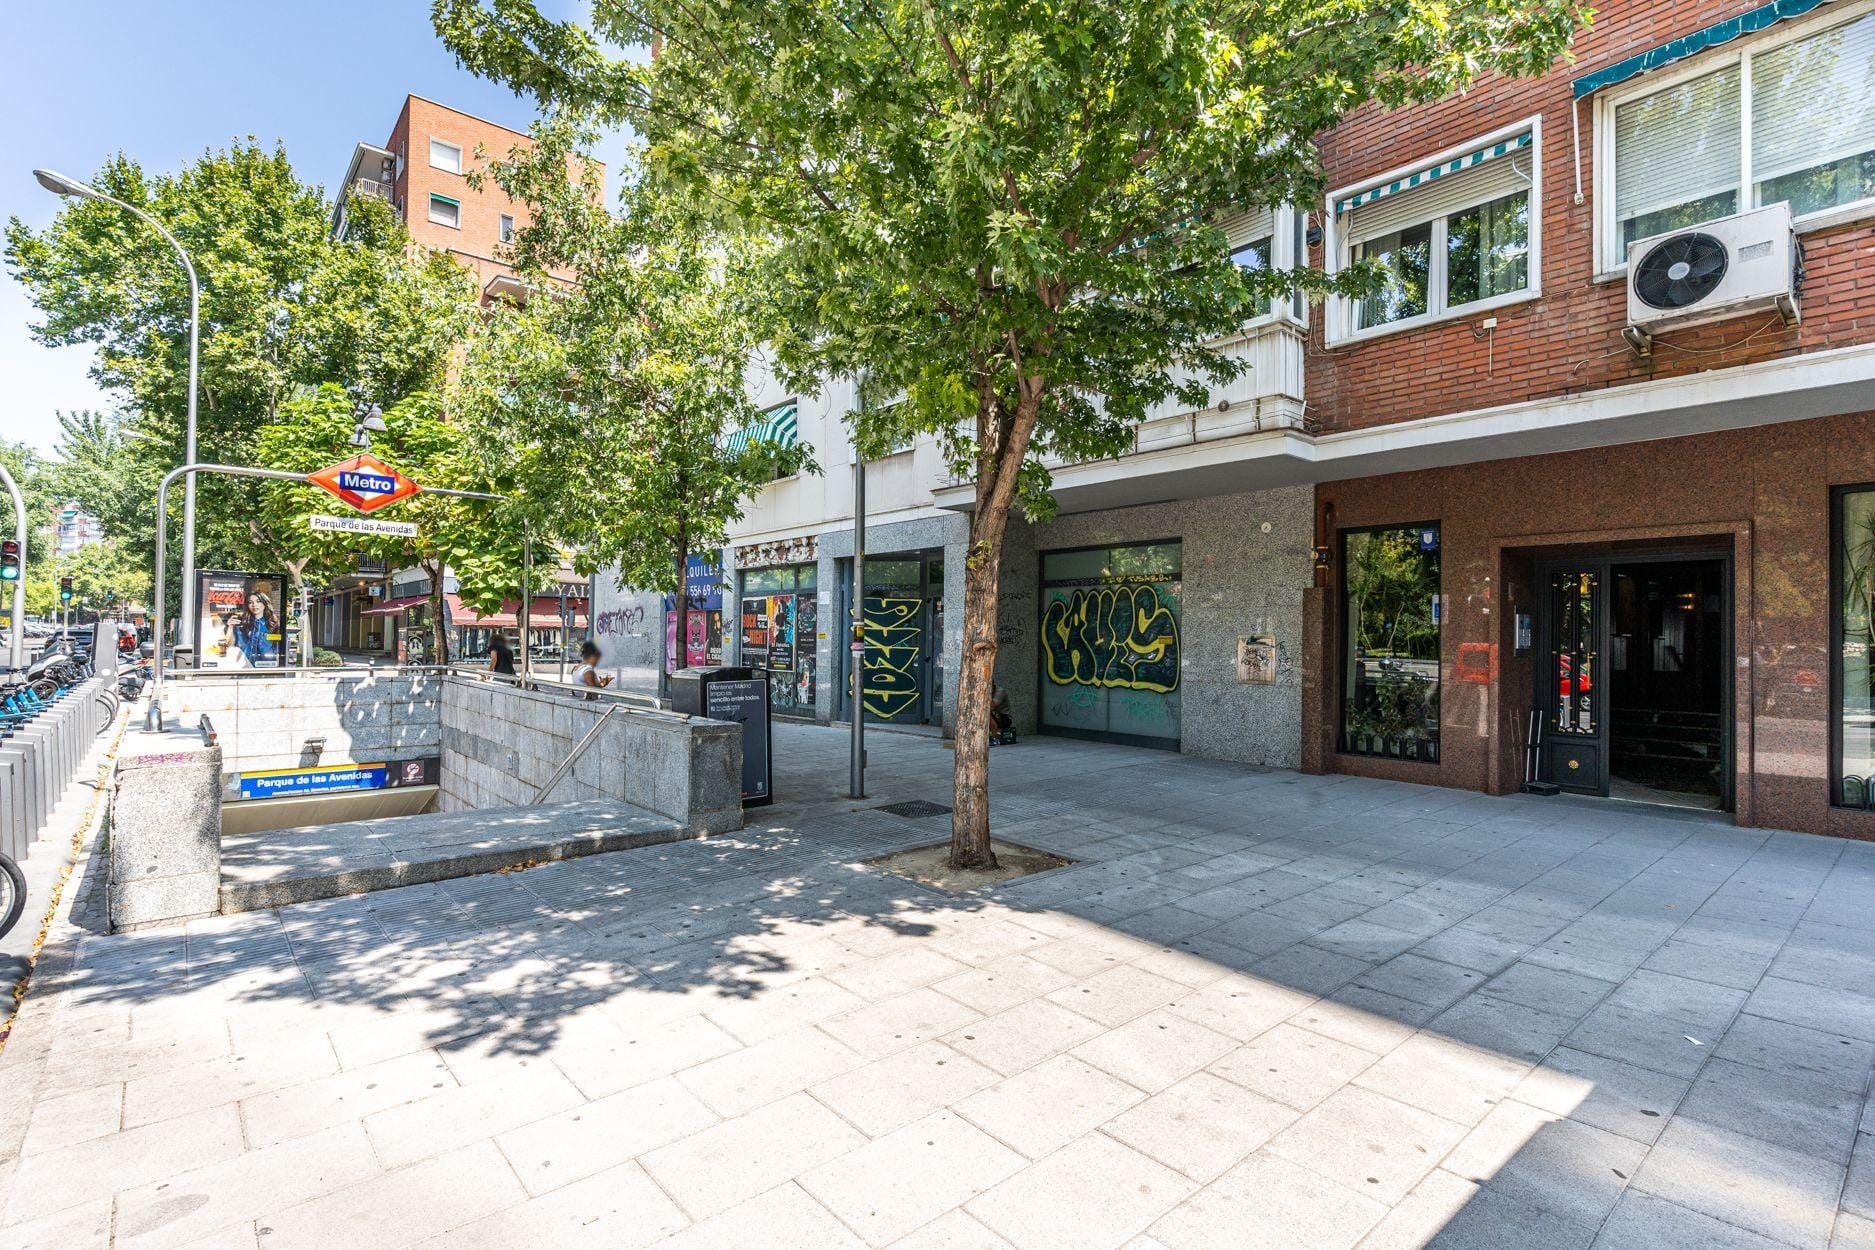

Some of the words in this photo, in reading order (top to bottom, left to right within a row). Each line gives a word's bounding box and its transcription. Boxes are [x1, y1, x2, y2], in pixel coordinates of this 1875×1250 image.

[344, 474, 391, 491] Metro
[314, 518, 347, 530] Parque
[348, 520, 360, 530] de
[361, 521, 375, 531] las
[376, 523, 413, 533] Avenidas
[555, 584, 590, 598] YAI
[257, 778, 294, 789] Parque
[296, 776, 310, 785] de
[311, 774, 327, 784] las
[329, 771, 373, 782] Avenidas
